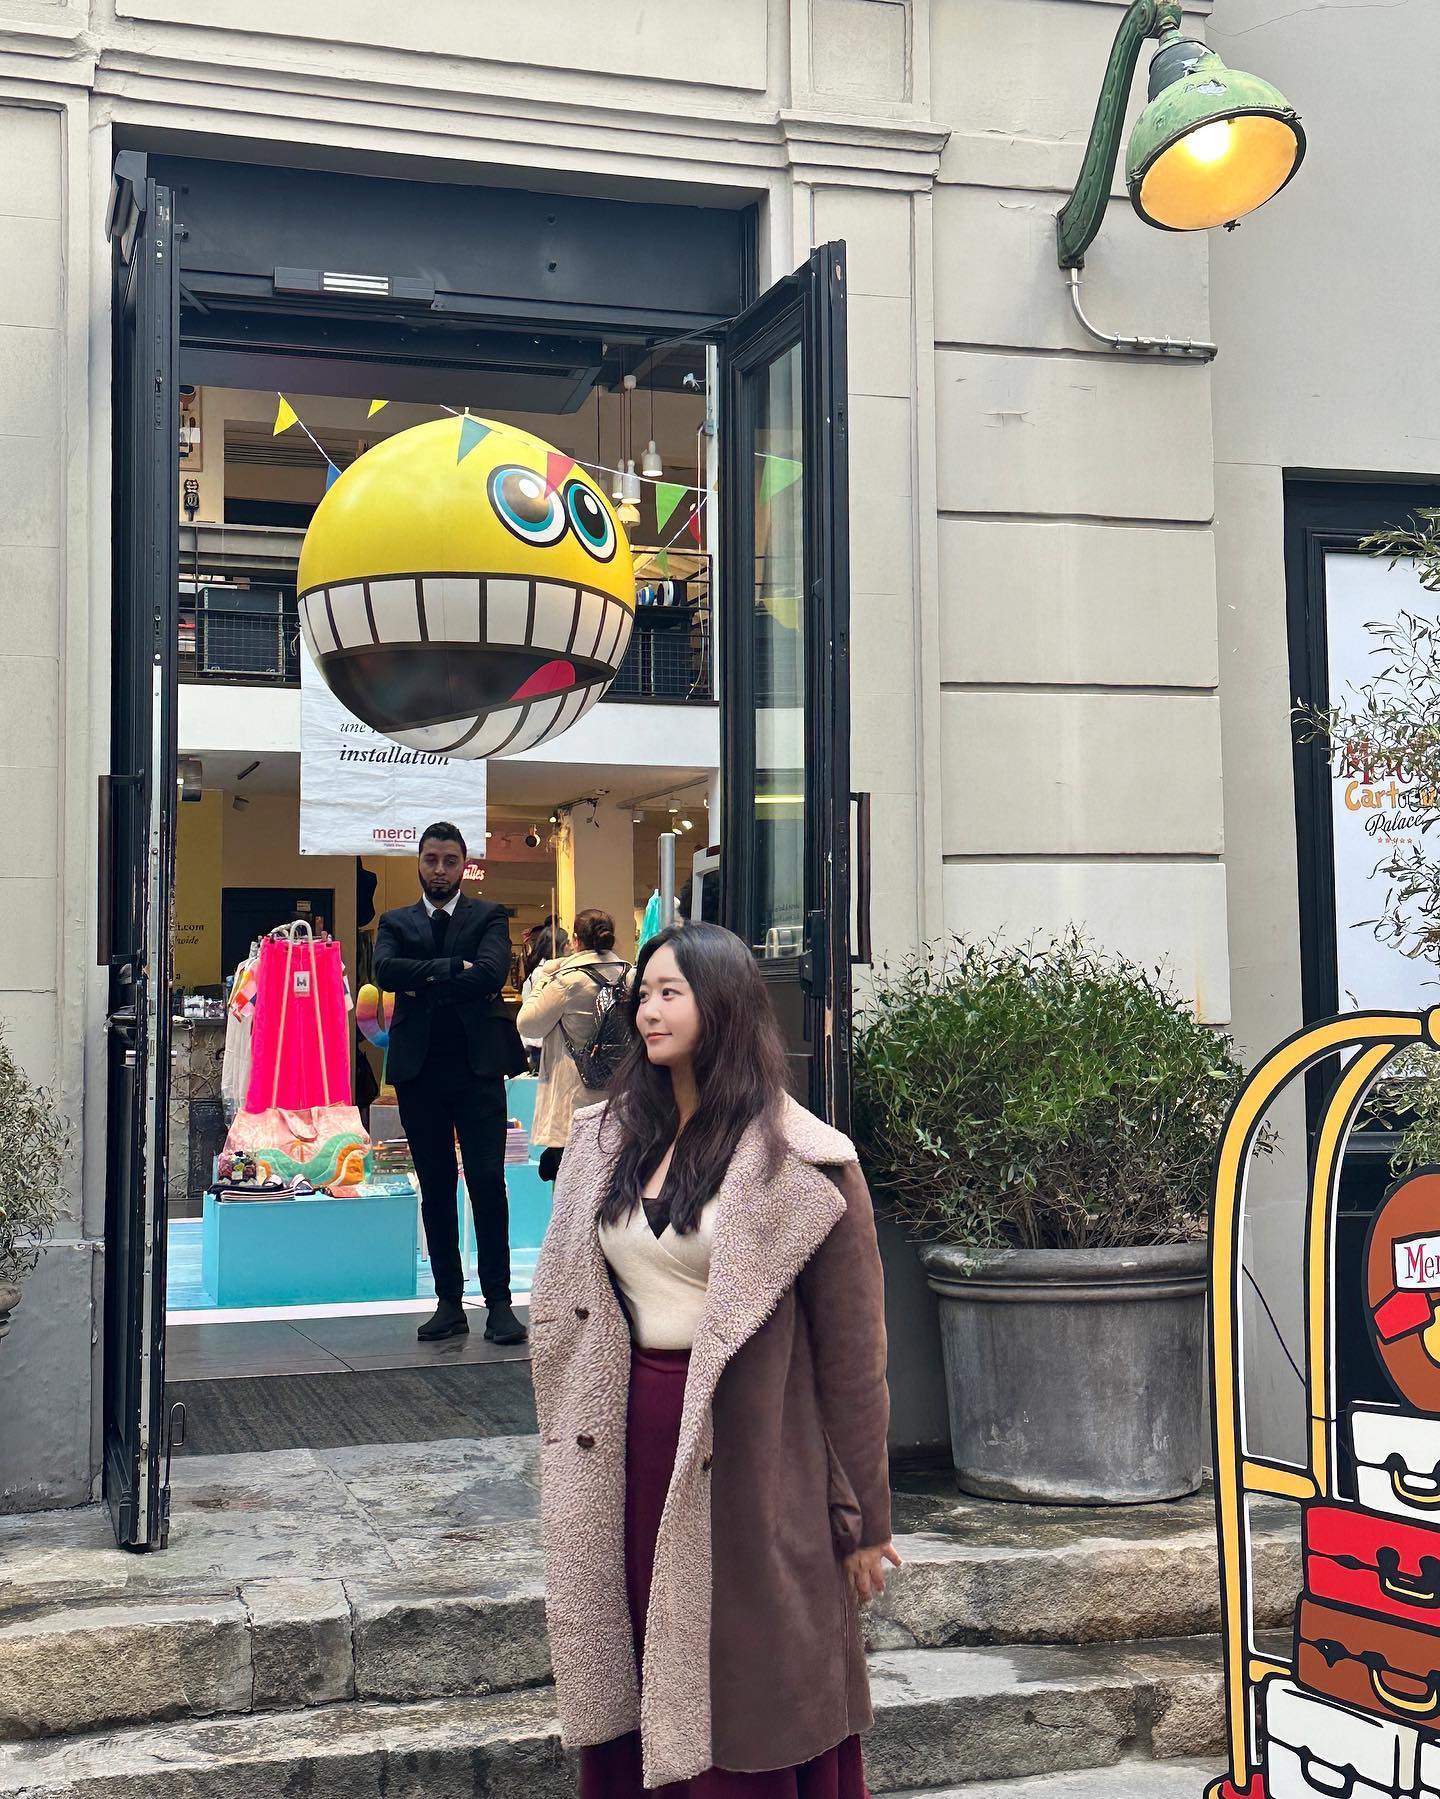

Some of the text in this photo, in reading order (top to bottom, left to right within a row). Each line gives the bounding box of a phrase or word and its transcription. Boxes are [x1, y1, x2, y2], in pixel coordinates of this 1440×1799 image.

[340, 723, 367, 733] une
[340, 744, 450, 766] installation
[1364, 810, 1424, 837] Palace
[372, 826, 417, 840] merci
